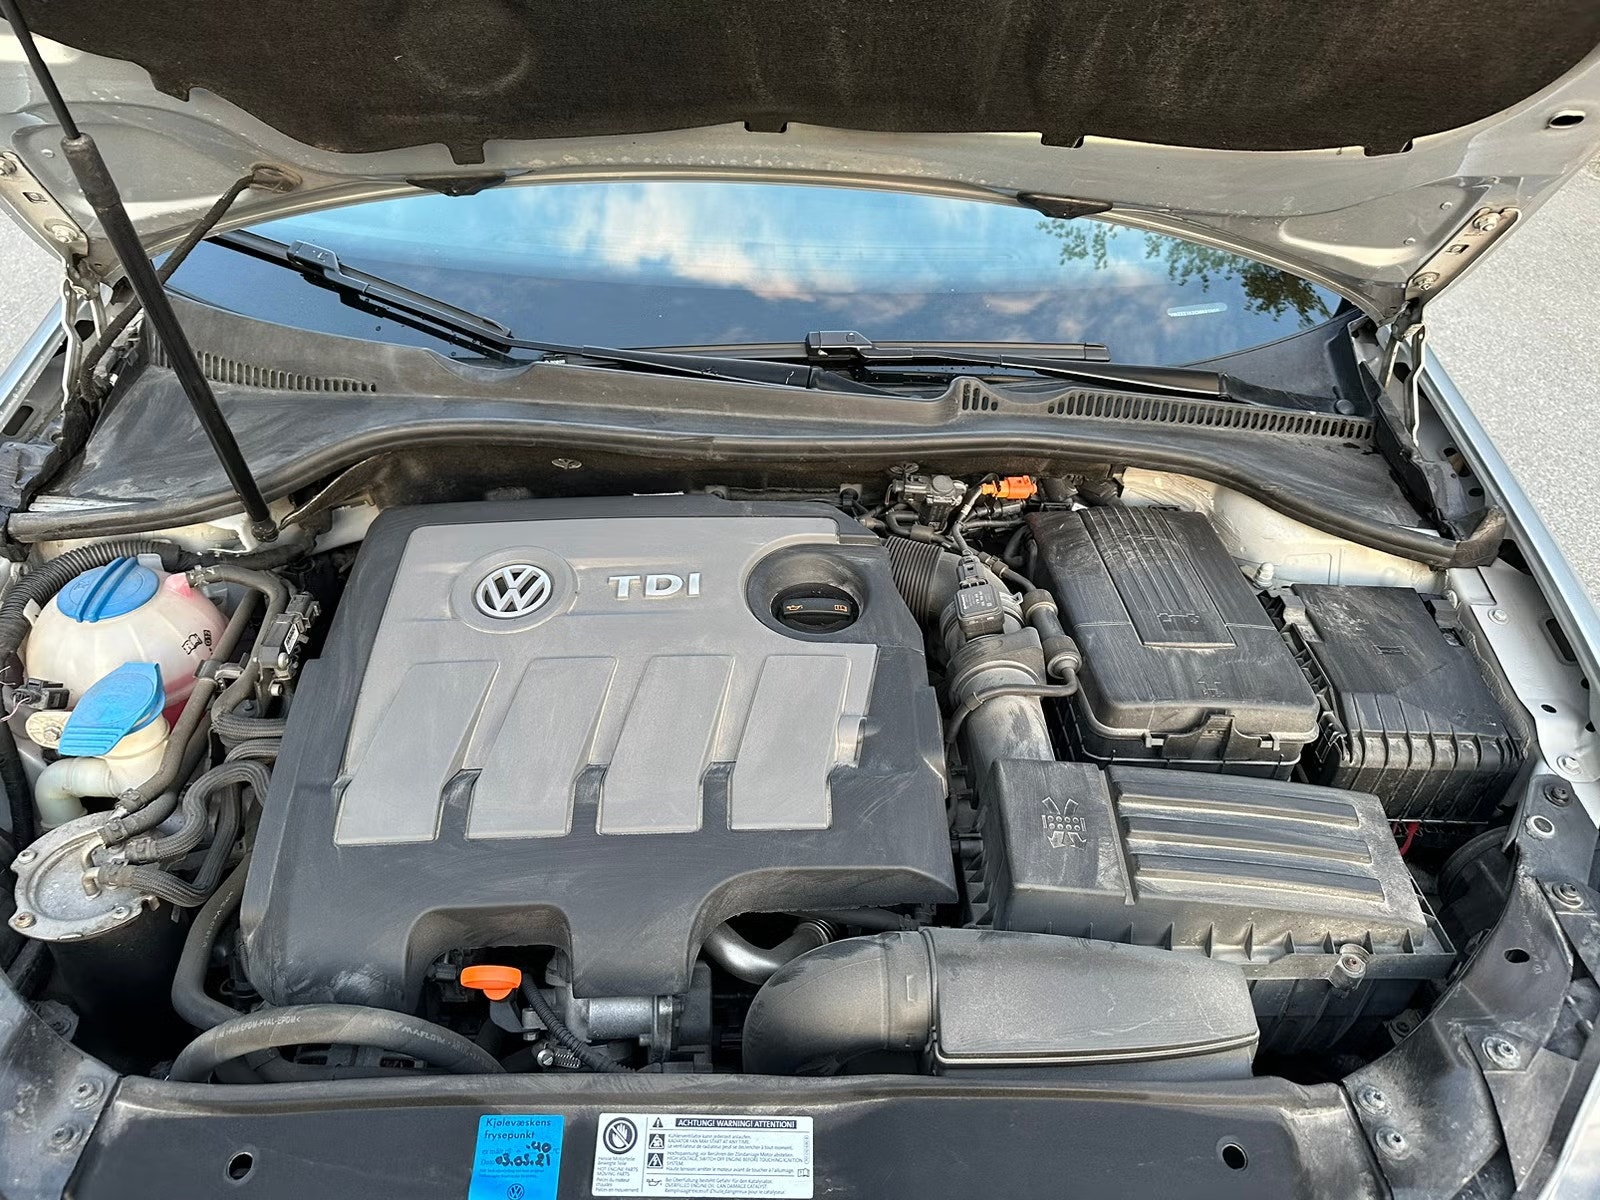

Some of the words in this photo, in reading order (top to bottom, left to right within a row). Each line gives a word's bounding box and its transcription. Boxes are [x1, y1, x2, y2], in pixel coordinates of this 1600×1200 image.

[607, 572, 701, 599] TDI
[486, 1117, 551, 1129] Kjølevæskens
[677, 1119, 716, 1127] ACHTUNG!
[716, 1120, 753, 1128] WARNING!
[754, 1120, 795, 1128] ATTENTION!
[484, 1130, 535, 1141] frysepunkt
